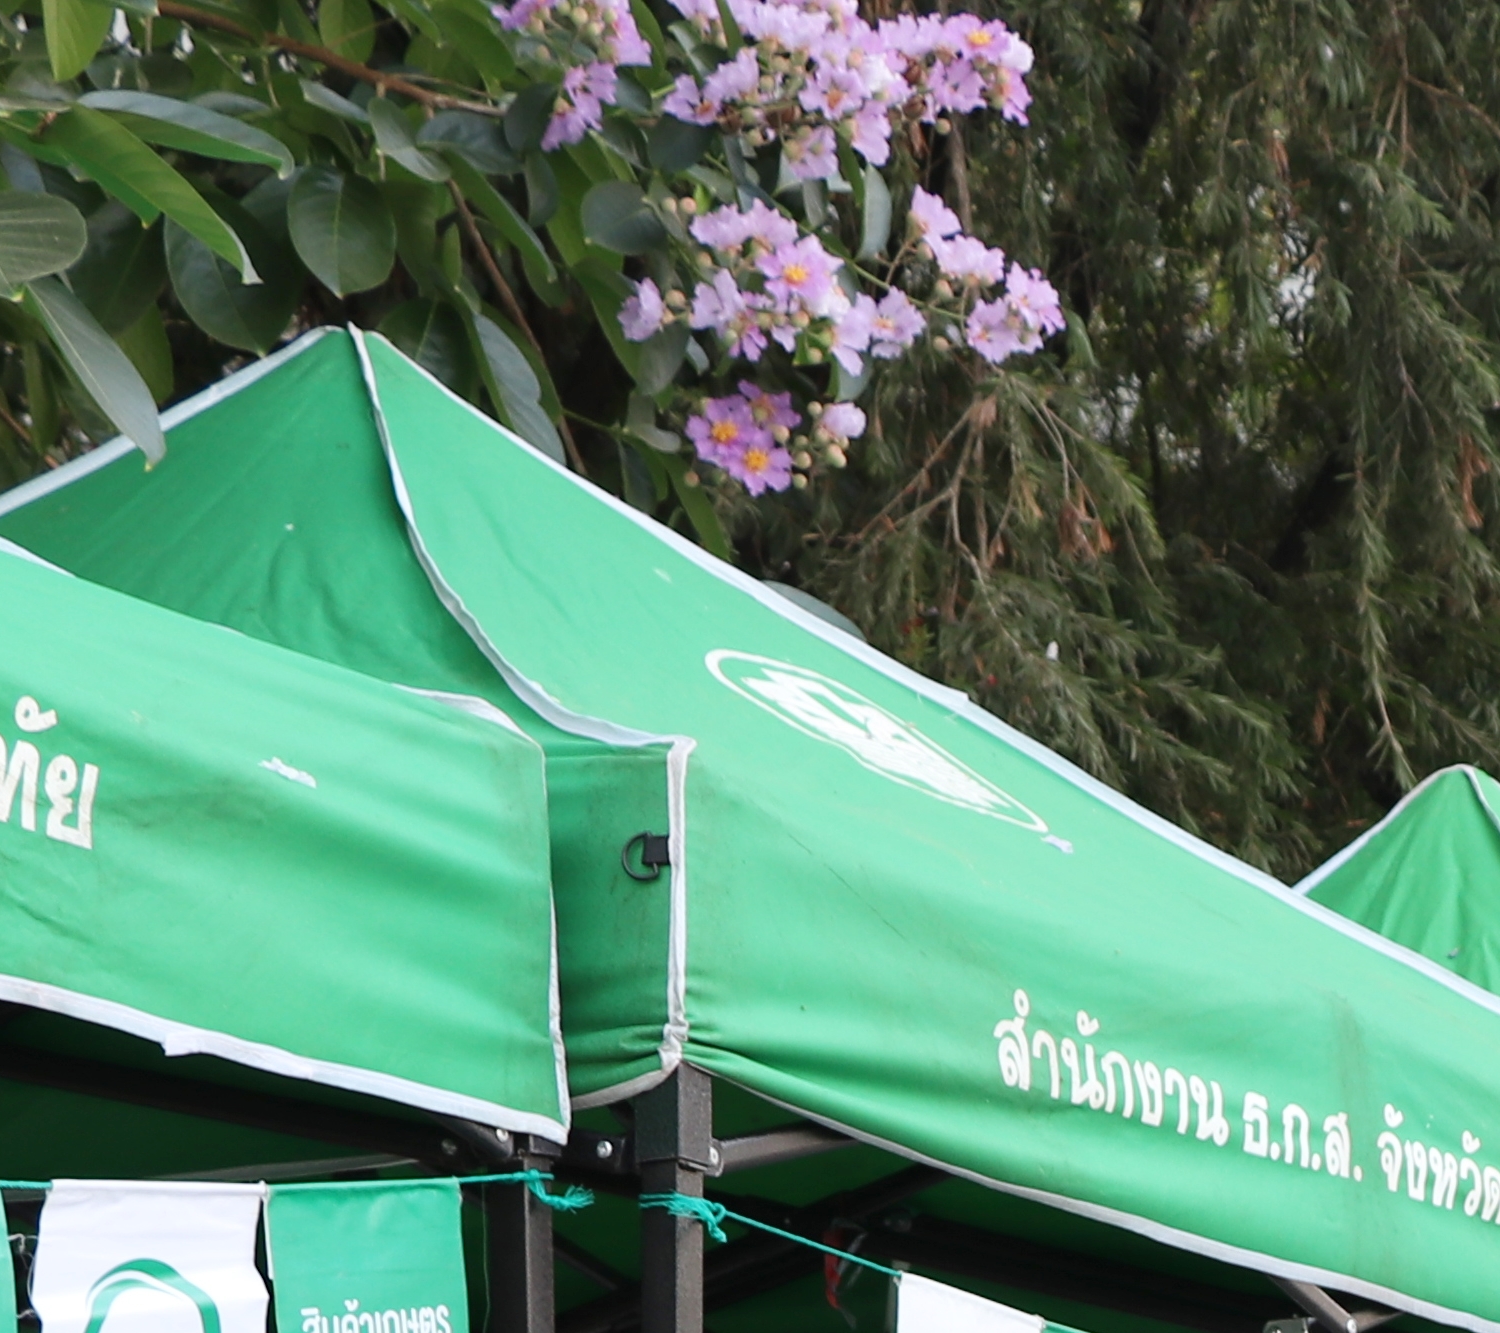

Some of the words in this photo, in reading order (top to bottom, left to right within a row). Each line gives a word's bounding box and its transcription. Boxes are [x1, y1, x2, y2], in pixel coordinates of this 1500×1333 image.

[993, 988, 1230, 1147] สำนักงาน
[1242, 1090, 1364, 1183] ธ.ก.ส.
